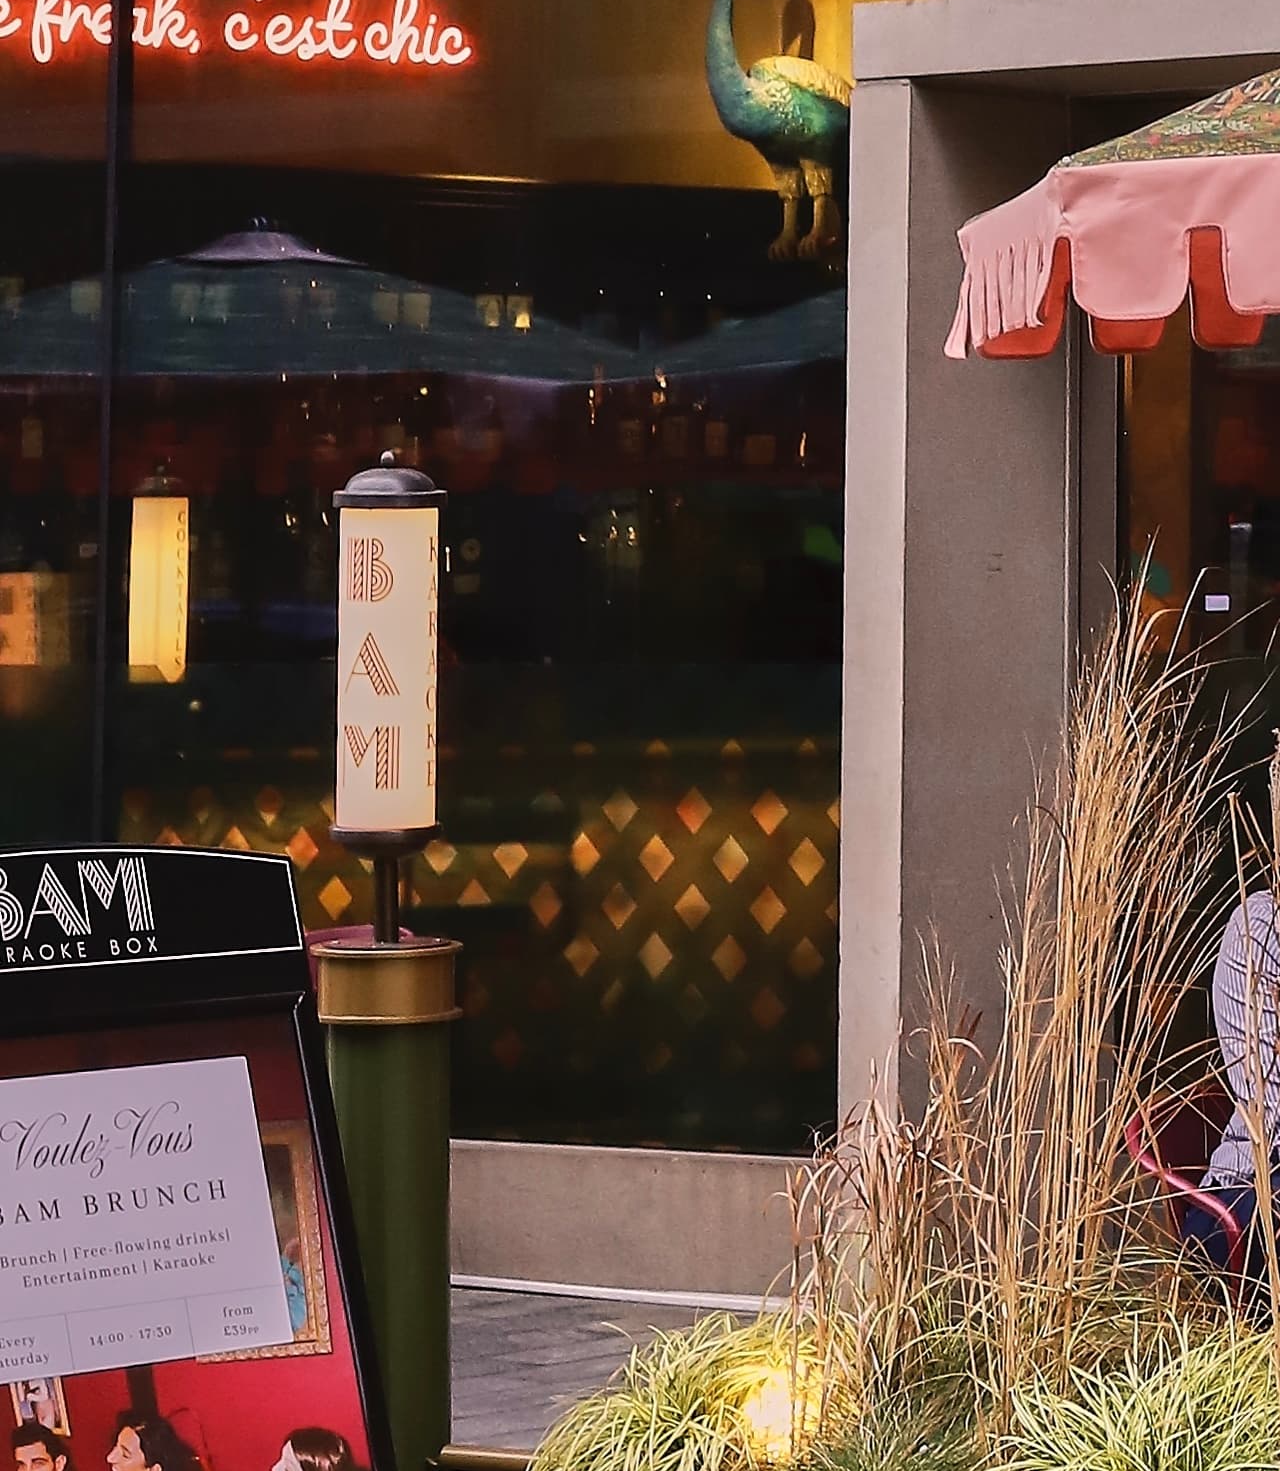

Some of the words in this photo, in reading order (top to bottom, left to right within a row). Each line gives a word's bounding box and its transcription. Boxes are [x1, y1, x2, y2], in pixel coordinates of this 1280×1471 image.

[343, 537, 400, 790] BAM
[109, 935, 158, 956] BOX
[0, 1100, 194, 1179] Voulez-Vous
[0, 1198, 62, 1226] AM
[83, 1178, 228, 1216] BRUNCH
[0, 1249, 58, 1269] Brunch
[72, 1238, 172, 1261] Free-flowing
[22, 1262, 139, 1289] Entertainment
[152, 1252, 217, 1272] Karaoke
[222, 1305, 254, 1318] from
[89, 1331, 125, 1347] 14:00
[138, 1325, 173, 1340] 17:30
